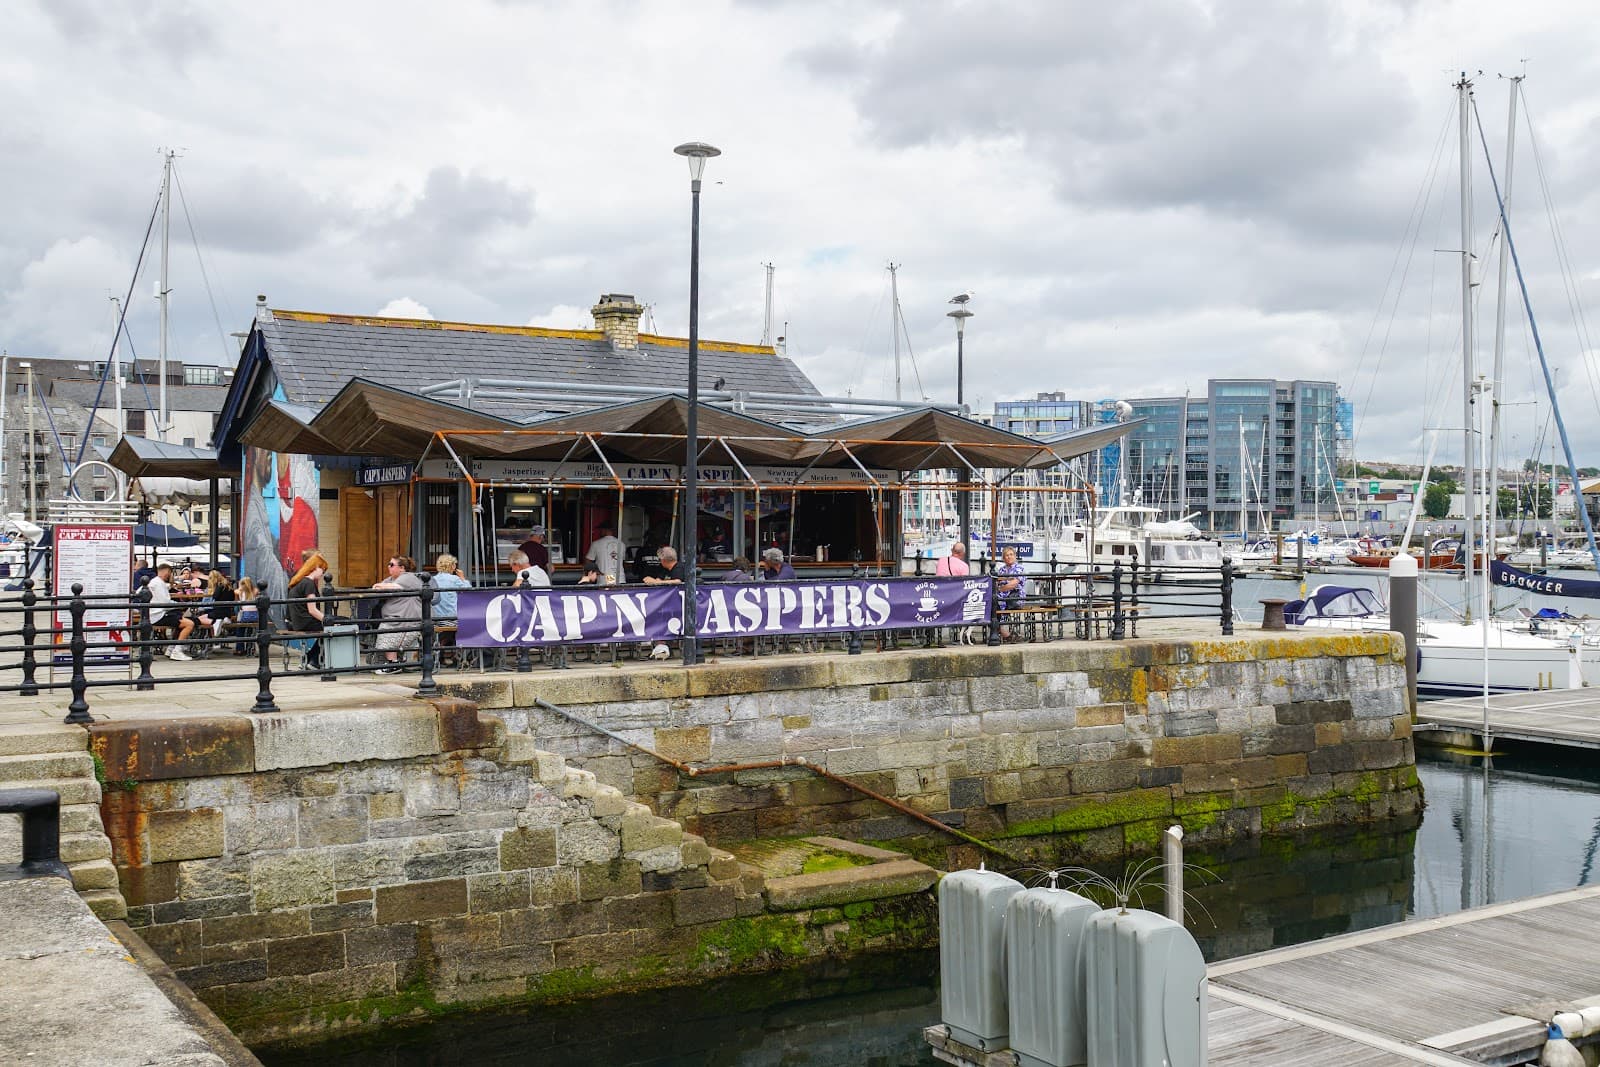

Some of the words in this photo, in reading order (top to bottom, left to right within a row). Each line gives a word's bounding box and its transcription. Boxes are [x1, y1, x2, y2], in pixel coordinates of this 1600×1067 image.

[381, 466, 407, 481] JASPERS
[627, 468, 671, 479] CAP'N
[59, 532, 86, 540] CAP'N
[914, 582, 928, 592] MUG
[1501, 571, 1563, 593] GROWLER
[485, 593, 648, 643] CAP'N
[667, 583, 890, 635] JASPERS
[914, 612, 925, 624] TEA
